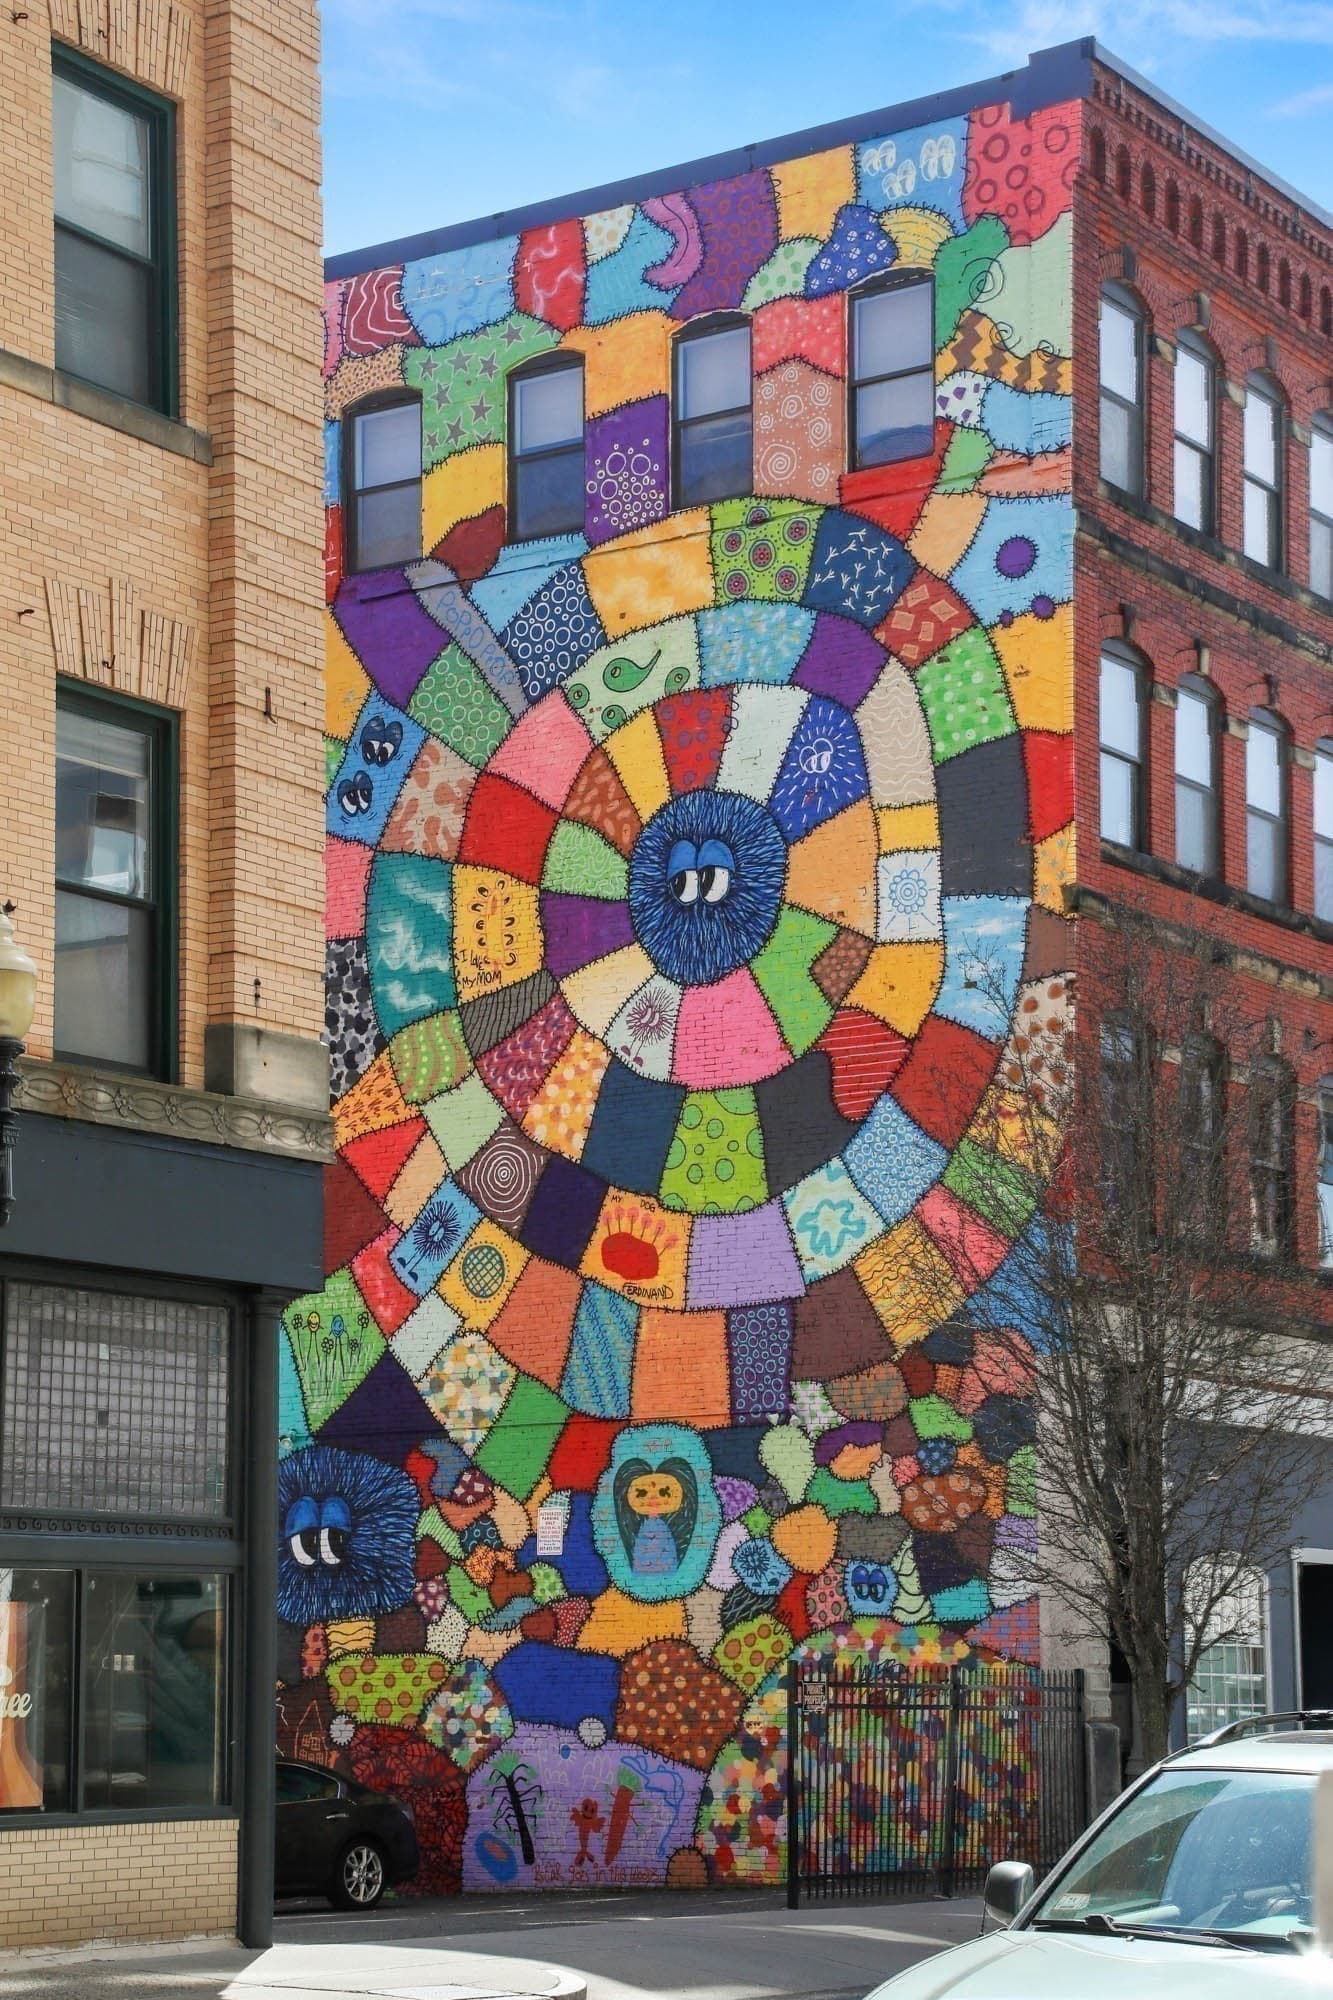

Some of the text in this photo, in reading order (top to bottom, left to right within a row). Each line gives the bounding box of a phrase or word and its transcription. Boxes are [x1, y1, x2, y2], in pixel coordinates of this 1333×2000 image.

[476, 970, 502, 985] MOM
[640, 1199, 656, 1213] DOG
[622, 1282, 674, 1302] FERDINAND
